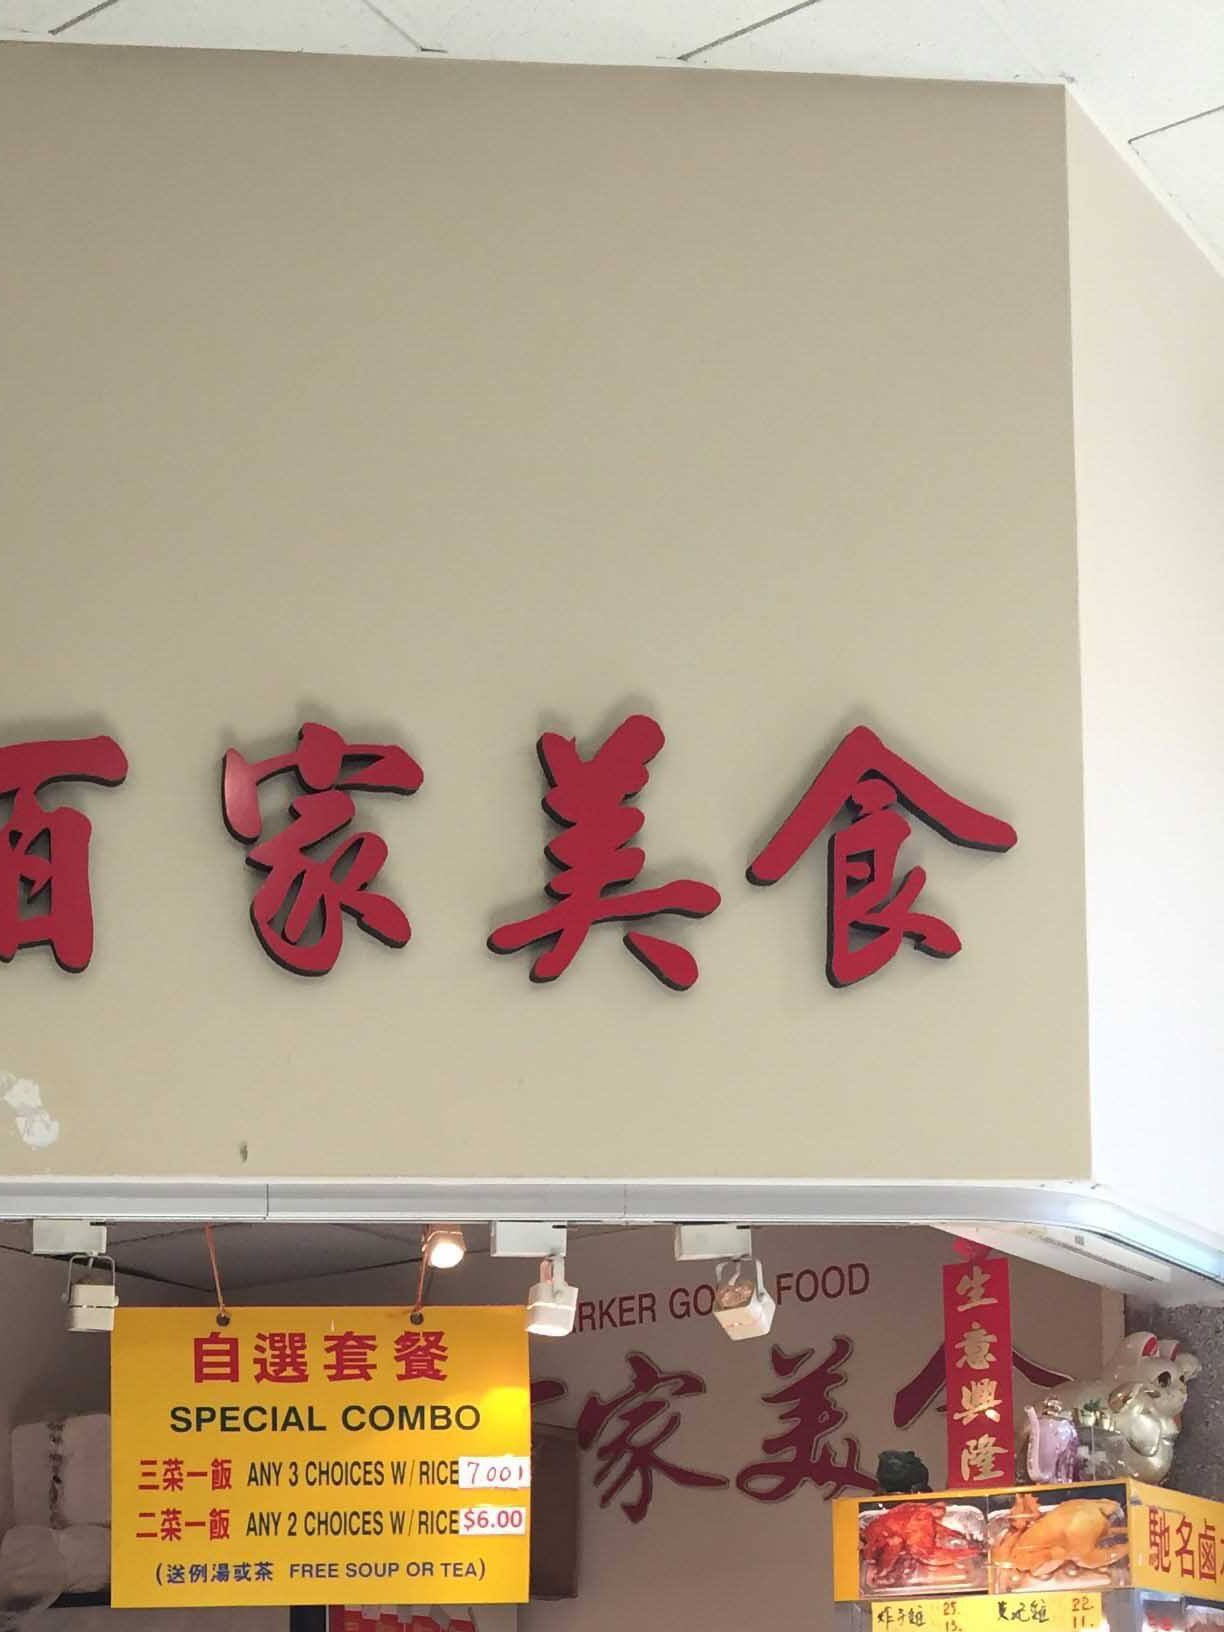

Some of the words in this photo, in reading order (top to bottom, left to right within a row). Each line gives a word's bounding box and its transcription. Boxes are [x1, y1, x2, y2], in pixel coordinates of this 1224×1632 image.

[572, 1294, 657, 1334] RKER
[776, 1262, 871, 1305] FOOD
[193, 1331, 449, 1384] 自選套餐
[953, 1265, 1009, 1482] 生意興隆
[170, 1405, 326, 1433] SPECIAL
[341, 1404, 481, 1431] COMBO
[137, 1458, 233, 1493] 三菜一飯
[247, 1462, 282, 1487] ANY
[288, 1461, 299, 1486] 3
[305, 1461, 385, 1486] CHOICES
[136, 1508, 231, 1541] 二菜一飯
[246, 1512, 281, 1536] ANY
[286, 1511, 298, 1536] 2
[303, 1511, 384, 1536] CHOICES
[463, 1508, 523, 1532] $6.00
[1148, 1505, 1224, 1583] 馳名鹵
[290, 1563, 339, 1578] FREE
[345, 1563, 400, 1577] SOUP
[406, 1563, 435, 1577] OR
